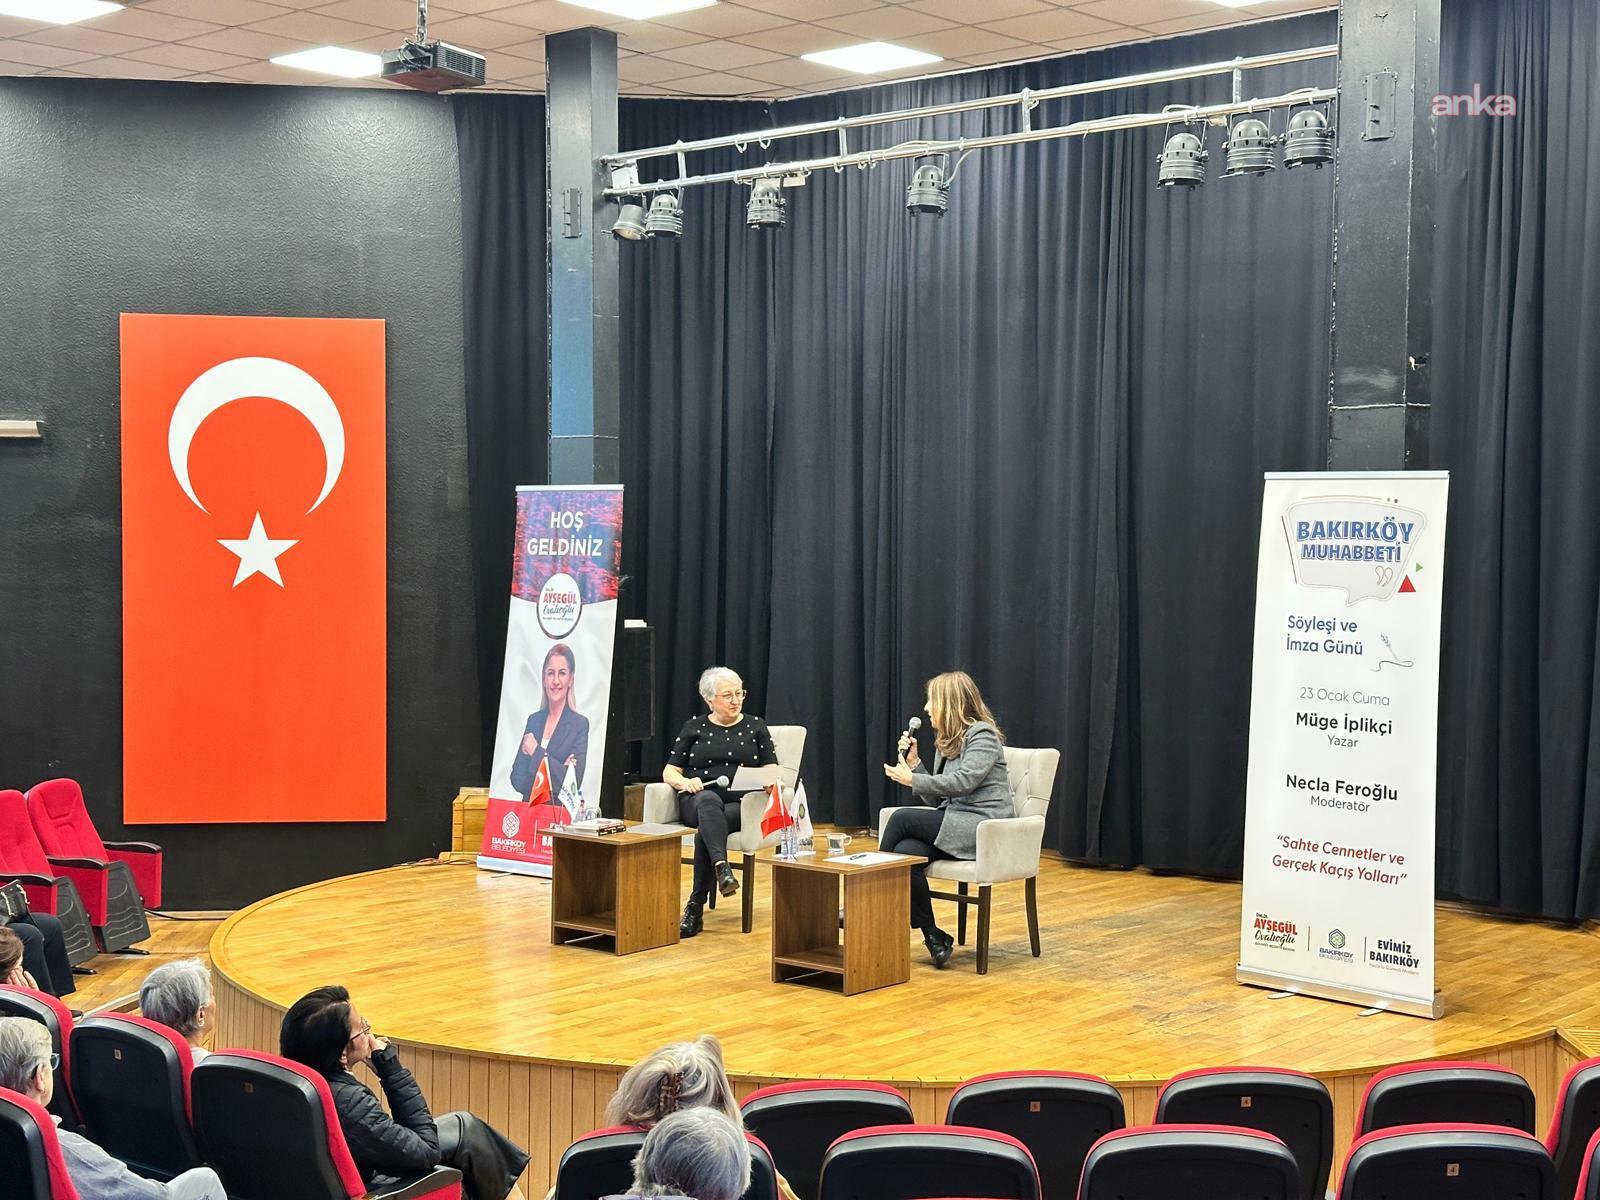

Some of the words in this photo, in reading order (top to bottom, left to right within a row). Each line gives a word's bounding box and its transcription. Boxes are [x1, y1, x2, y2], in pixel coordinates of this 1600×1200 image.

[550, 512, 584, 532] HOŞ
[1296, 516, 1414, 544] BAKIRKÖY
[528, 534, 603, 556] GELDİNİZ
[1301, 542, 1401, 562] MUHABBETİ
[1288, 615, 1336, 634] Söyleşi
[1340, 620, 1358, 632] ve
[1286, 633, 1319, 652] İmza
[1323, 639, 1363, 656] Günü
[1300, 686, 1314, 699] 23
[1317, 688, 1350, 704] Ocak
[1352, 692, 1390, 706] Cuma
[1296, 712, 1338, 730] Müge
[1344, 713, 1393, 736] İplikçi
[1327, 734, 1359, 748] Yazar
[1286, 774, 1330, 792] Necla
[1335, 780, 1398, 801] Feroğlu
[1310, 796, 1370, 812] Moderatör
[1322, 842, 1386, 862] Cennetler
[1389, 854, 1405, 865] ve
[1272, 855, 1317, 873] Gerçek
[1320, 861, 1354, 880] Kaçış
[1254, 918, 1298, 935] AYŞEGÜL
[1378, 938, 1412, 954] EVİMİZ
[1370, 952, 1420, 968] BAKIRKÖY
